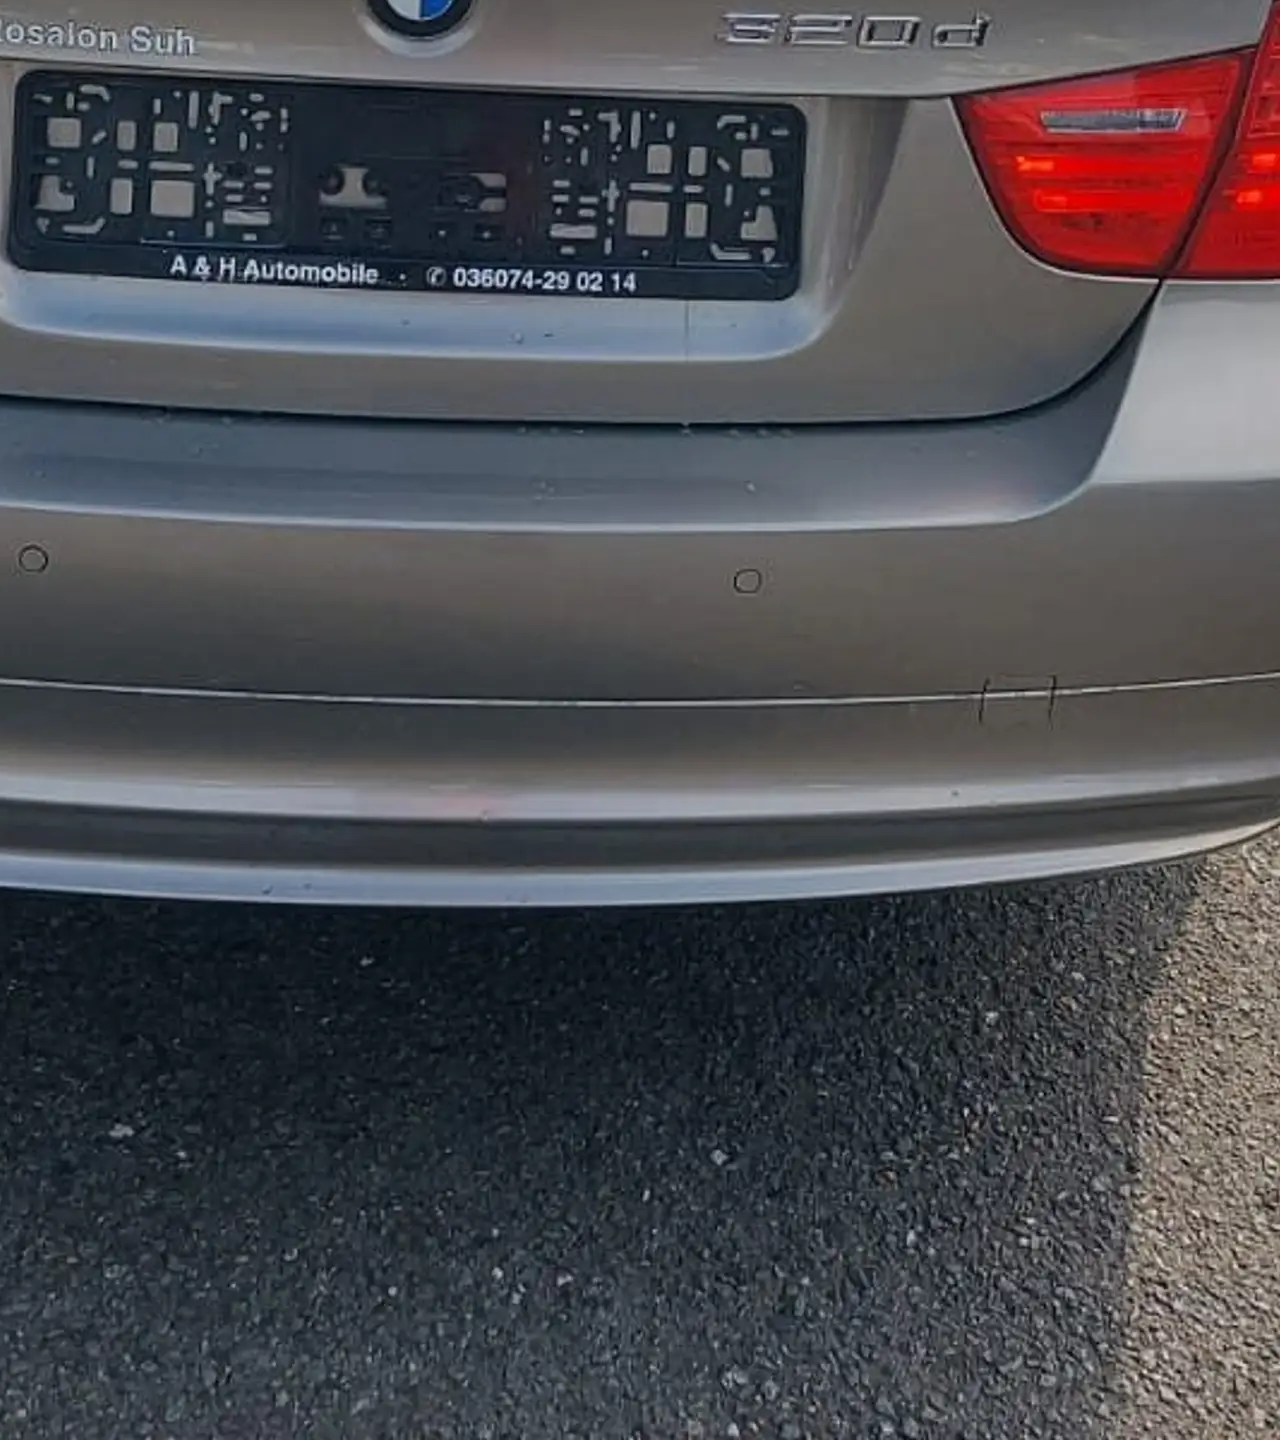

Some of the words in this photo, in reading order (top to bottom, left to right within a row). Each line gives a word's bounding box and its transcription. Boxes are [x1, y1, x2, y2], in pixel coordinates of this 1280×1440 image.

[129, 24, 196, 55] Suh
[718, 13, 992, 48] 320d
[169, 253, 188, 276] A
[194, 254, 212, 277] &
[219, 256, 237, 279] H
[242, 259, 379, 285] Automobile
[452, 267, 570, 291] 036074-29
[576, 271, 604, 293] 02
[610, 272, 638, 293] 14
